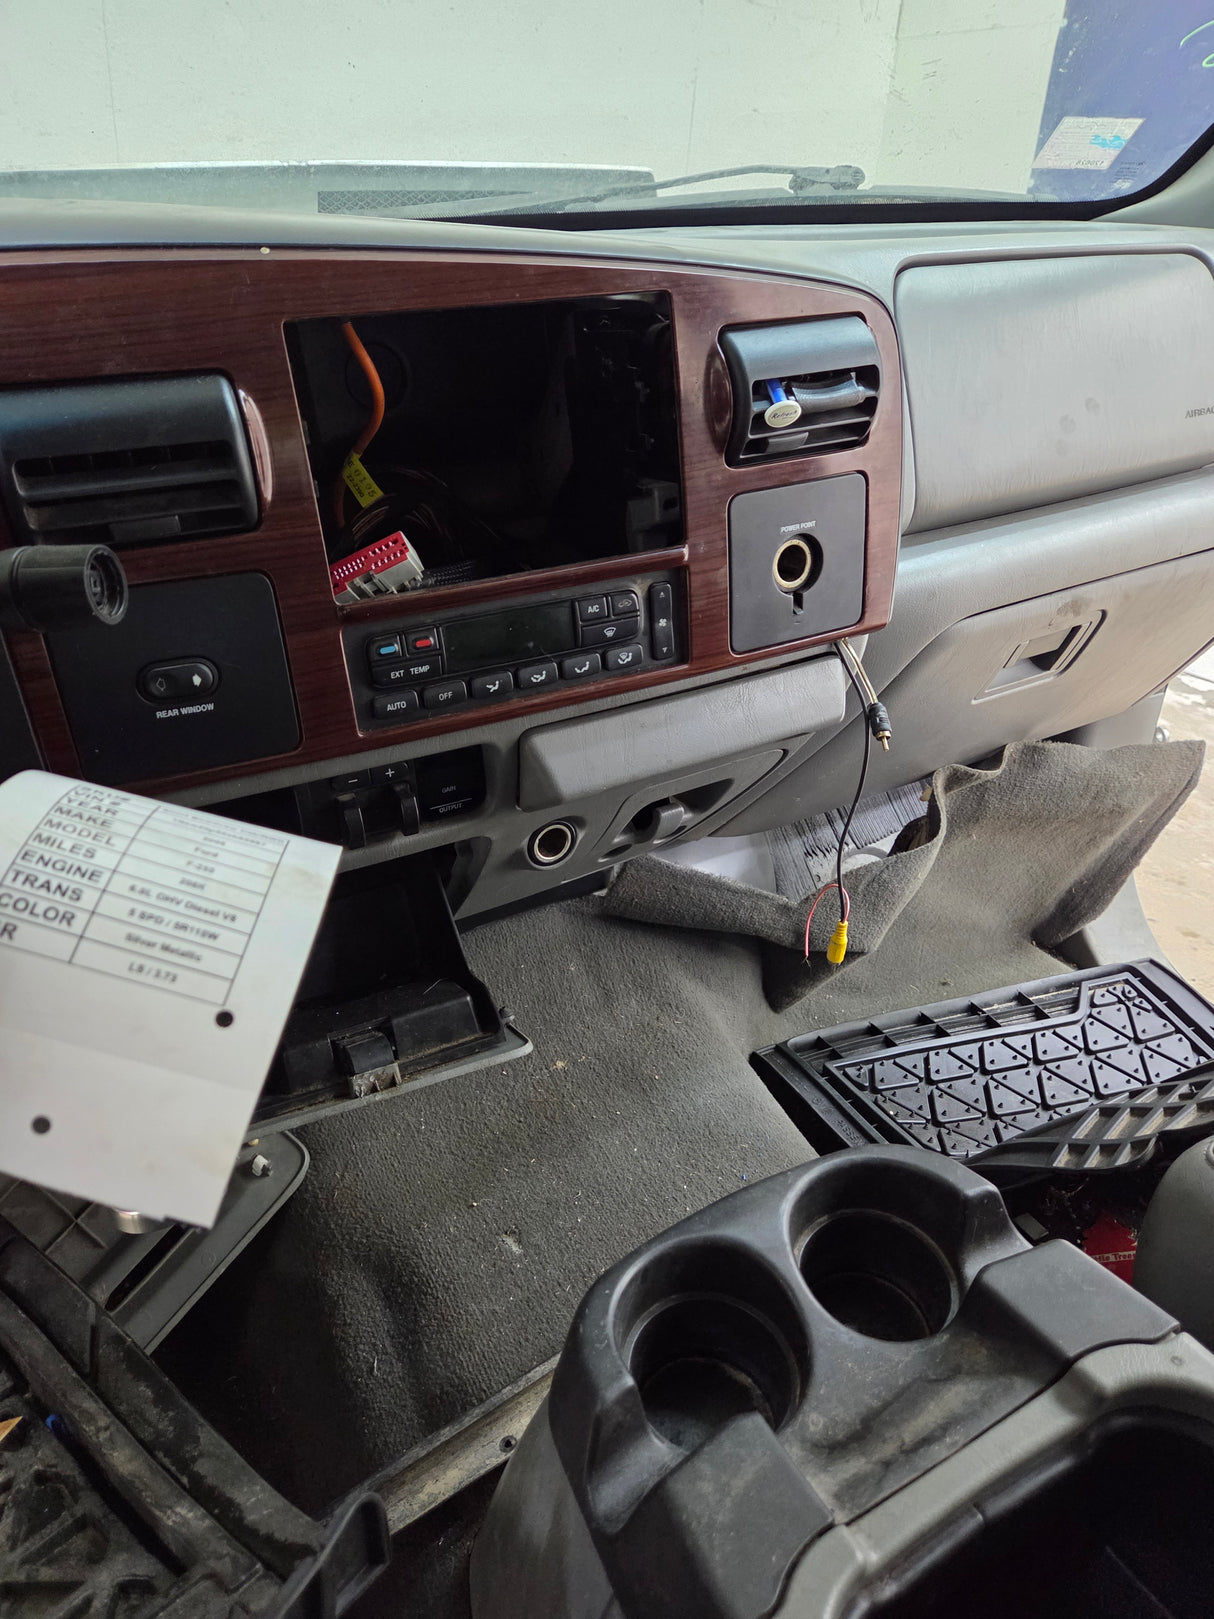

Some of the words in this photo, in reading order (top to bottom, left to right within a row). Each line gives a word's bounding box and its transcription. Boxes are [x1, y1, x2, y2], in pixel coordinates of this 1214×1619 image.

[780, 523, 800, 533] POWER
[800, 520, 817, 530] POINT
[587, 603, 600, 615] A/C
[390, 669, 404, 679] EXT
[410, 664, 430, 675] TEMP
[438, 690, 453, 702] OFF
[156, 708, 179, 719] REAR
[180, 703, 215, 715] WINDOW
[386, 700, 407, 712] AUTO
[441, 785, 457, 794] GAIN
[67, 796, 119, 816] YEAR
[438, 803, 463, 814] OUTPUT
[54, 806, 113, 828] MAKE
[43, 818, 116, 847] MODEL
[32, 832, 97, 860] MILES
[20, 849, 104, 884] ENGINE
[11, 868, 84, 902] TRANS
[0, 892, 76, 928] COLOR
